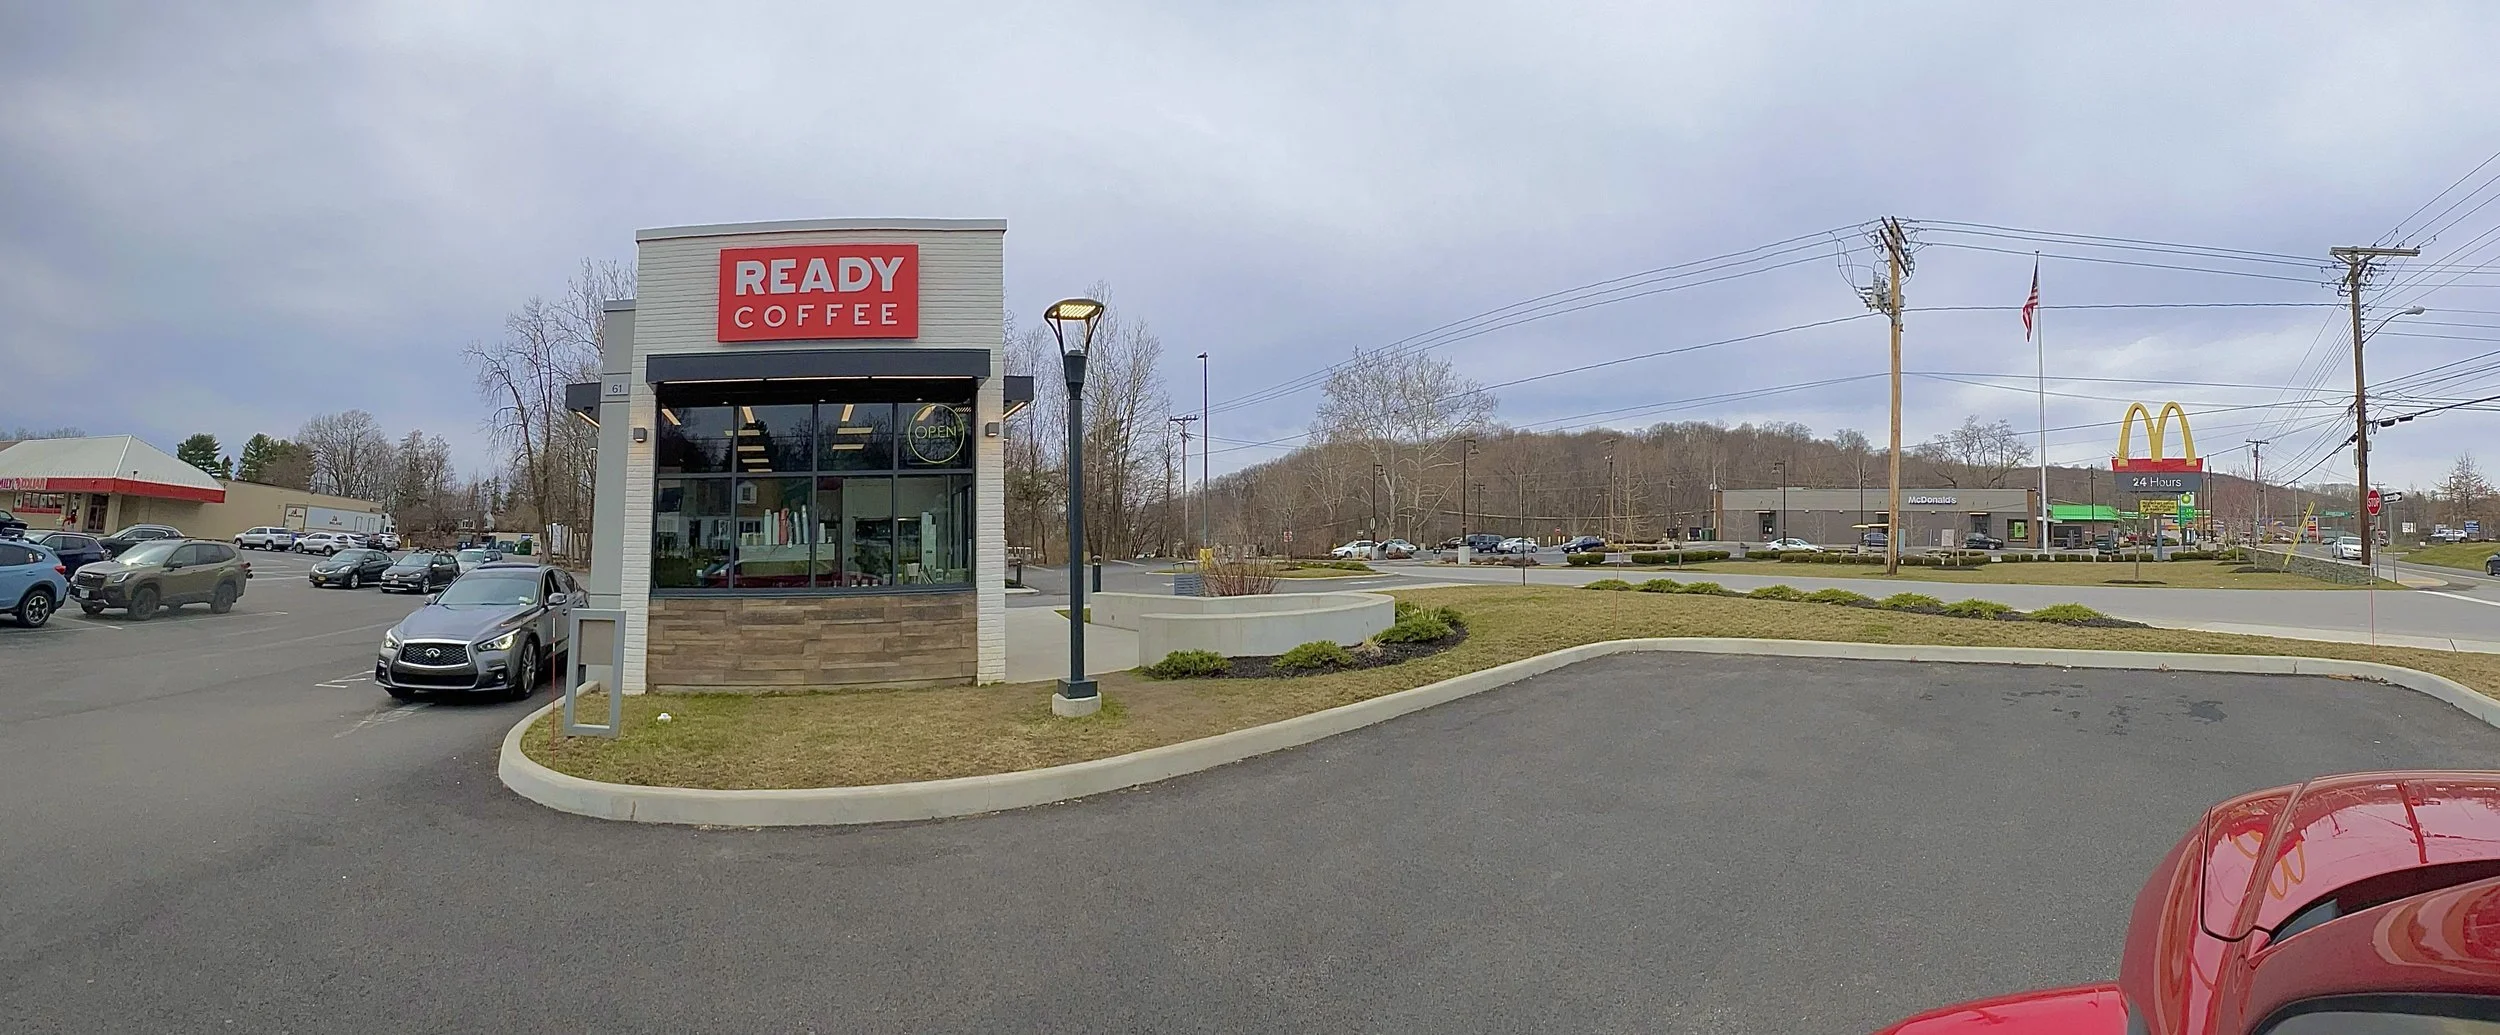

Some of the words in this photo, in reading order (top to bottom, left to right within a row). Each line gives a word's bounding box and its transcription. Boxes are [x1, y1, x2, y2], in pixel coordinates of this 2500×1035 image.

[735, 256, 906, 296] READY
[734, 303, 898, 329] COFFEE
[612, 384, 622, 394] 61
[914, 425, 957, 439] OPEN
[2132, 477, 2147, 487] 24
[2150, 476, 2182, 487] Hours
[1908, 496, 1957, 504] McDonald's
[2368, 497, 2380, 508] STOP
